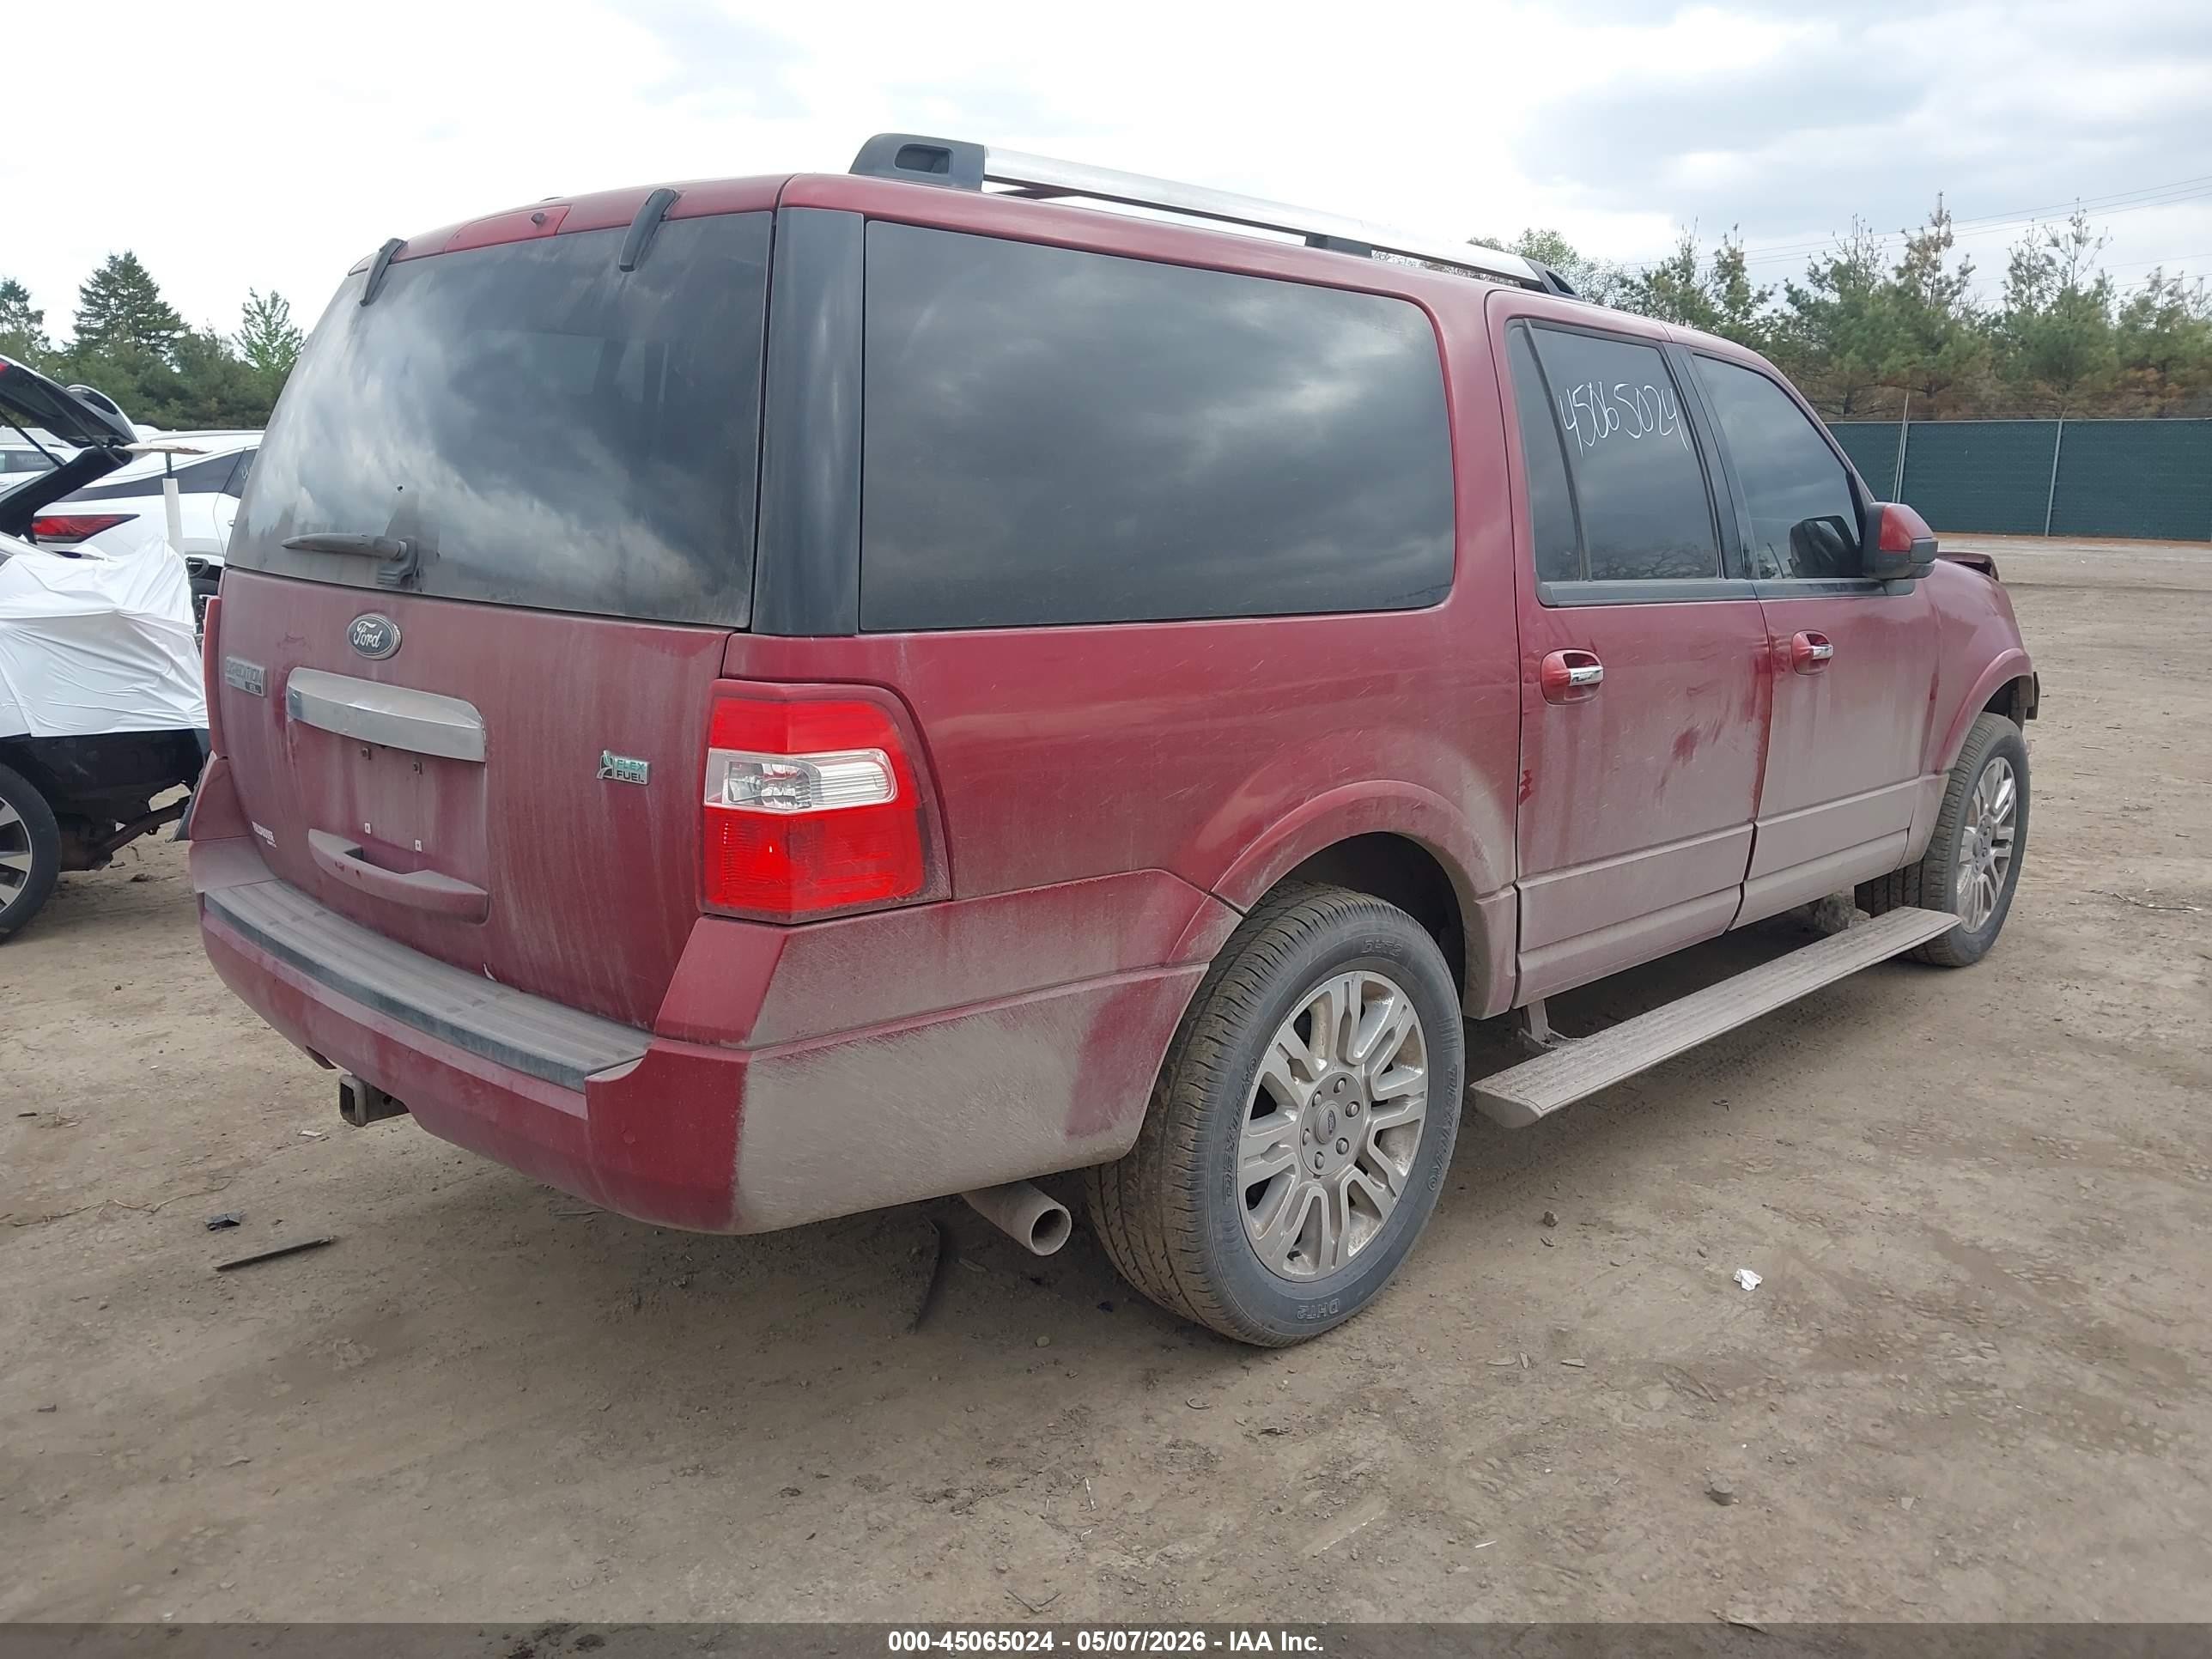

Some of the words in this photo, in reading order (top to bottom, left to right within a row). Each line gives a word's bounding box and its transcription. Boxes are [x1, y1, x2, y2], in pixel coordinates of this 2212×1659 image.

[1559, 381, 1689, 458] 45065024
[353, 621, 384, 649] Ford
[617, 759, 645, 771] FLEX
[617, 770, 645, 783] FUEL
[1296, 1298, 1340, 1321] DHT2
